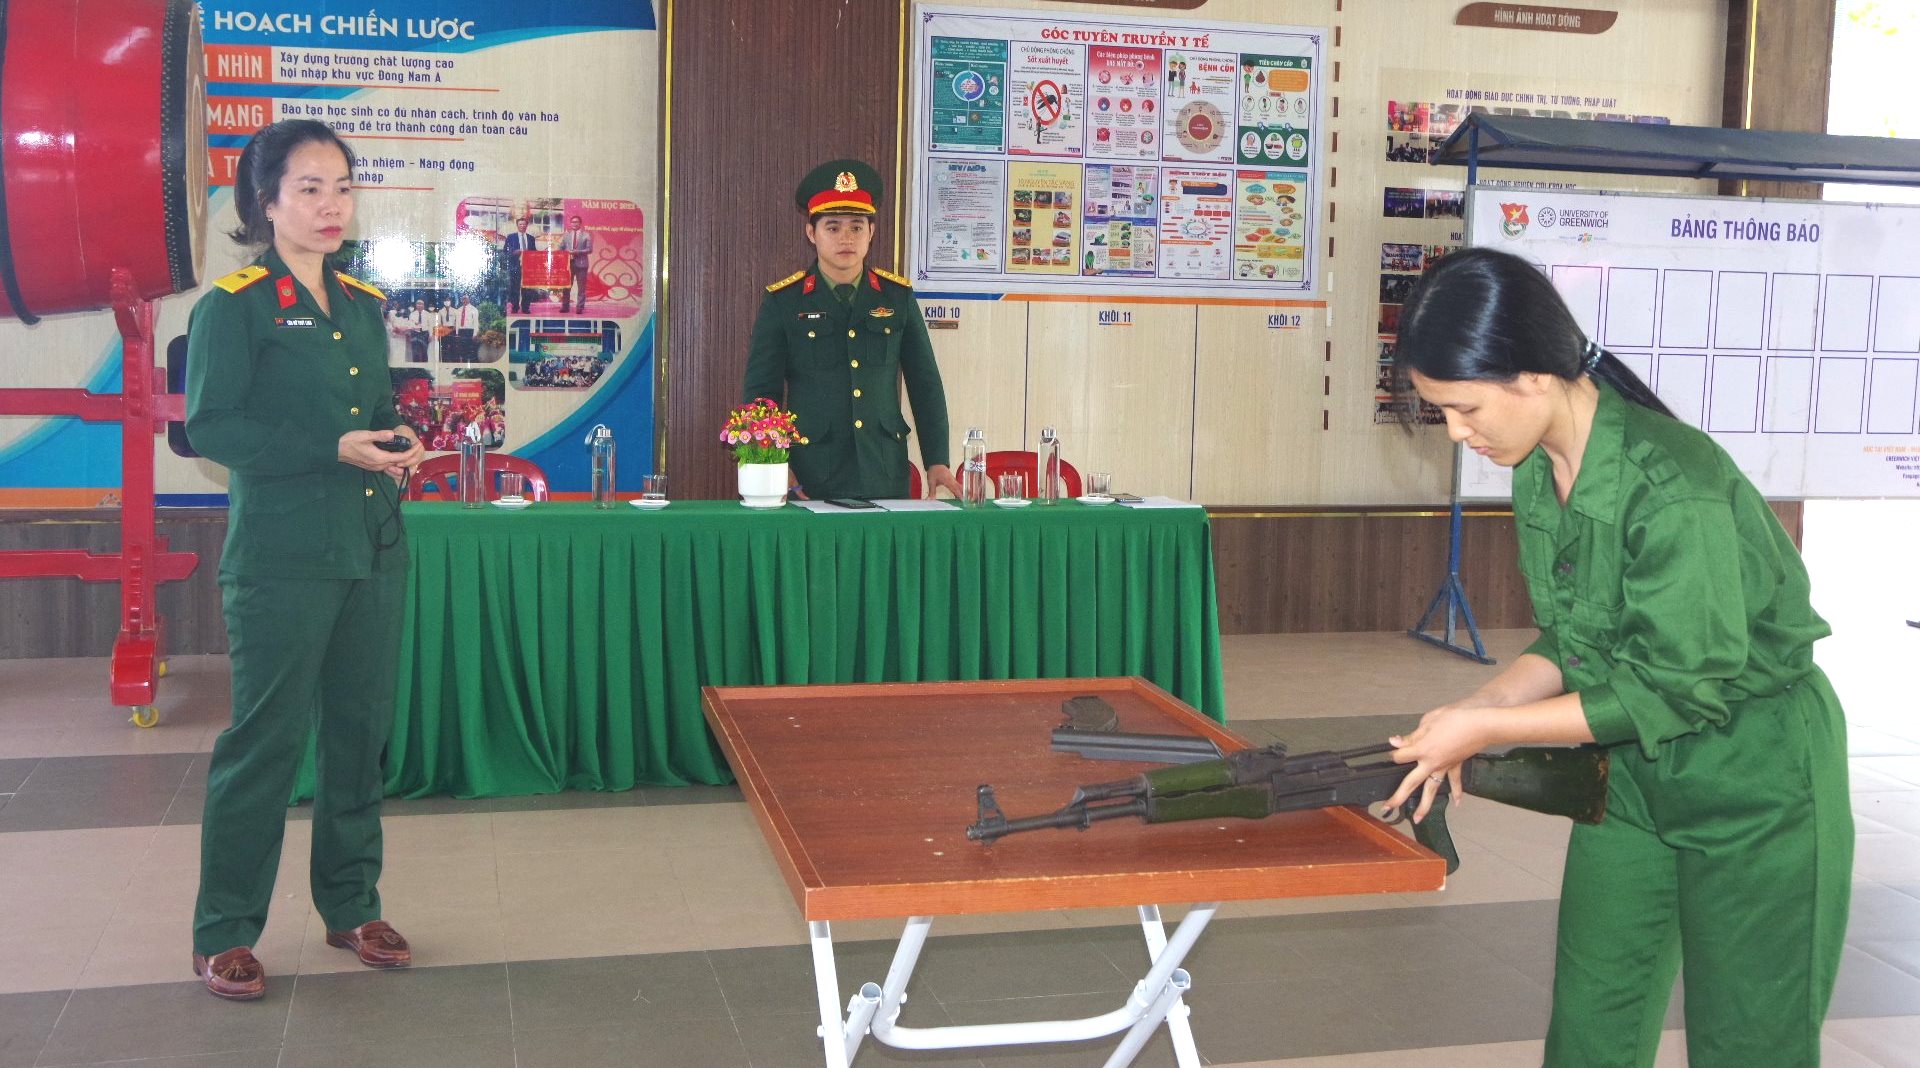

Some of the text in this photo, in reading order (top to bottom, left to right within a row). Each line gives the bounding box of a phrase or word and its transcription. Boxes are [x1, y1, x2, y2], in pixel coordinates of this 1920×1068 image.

[214, 10, 312, 36] HOẠCH
[320, 9, 398, 38] CHIẾN
[407, 18, 475, 43] LƯỢC
[1494, 7, 1515, 24] HÌNH
[1535, 12, 1556, 29] HOẠT
[1558, 13, 1581, 31] ĐỘNG
[1041, 26, 1210, 49] GÓC TUYÊN TRUYỀN Y TẾ
[218, 52, 263, 79] NHÌN
[304, 53, 330, 67] dựng
[402, 57, 431, 70] lượng
[436, 60, 454, 69] cao
[332, 69, 351, 79] khu
[356, 71, 374, 82] vực
[408, 71, 431, 82] Nam
[207, 104, 264, 130] MẠNG
[306, 104, 323, 116] tạo
[328, 105, 347, 117] học
[352, 105, 373, 117] sinh
[1560, 210, 1599, 218] UNIVERSITY
[1560, 218, 1609, 228] GREENWICH
[1671, 214, 1820, 243] BẢNG THÔNG BÁO
[950, 306, 960, 319] 10
[1123, 312, 1131, 323] 11
[1291, 315, 1301, 326] 12
